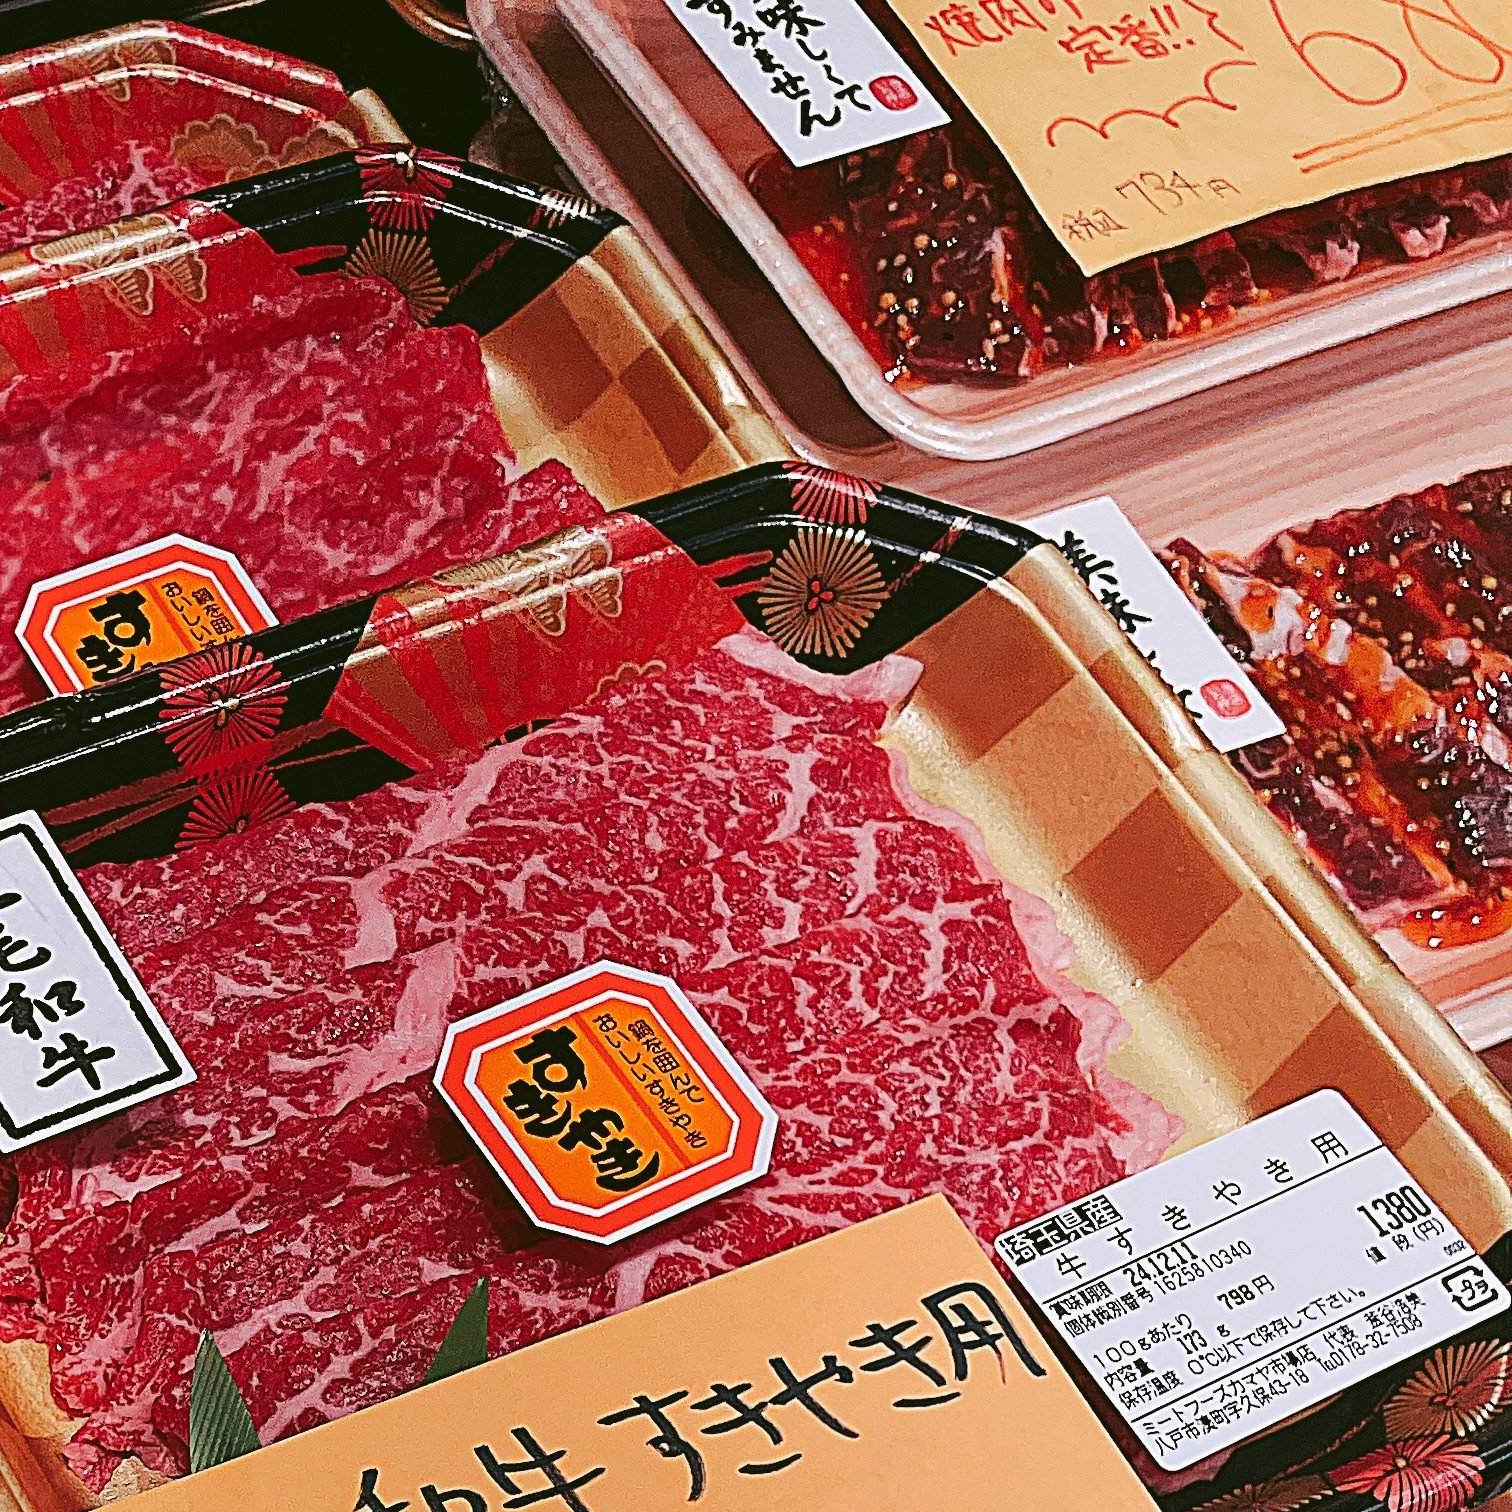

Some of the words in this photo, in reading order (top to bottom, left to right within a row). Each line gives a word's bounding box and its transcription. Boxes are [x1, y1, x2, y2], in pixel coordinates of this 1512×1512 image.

[1269, 0, 1512, 106] 68
[1114, 170, 1242, 216] 734円
[75, 590, 155, 683] すき
[191, 587, 240, 647] 鍋を囲
[592, 1013, 707, 1149] おいしいすきやき
[627, 1019, 705, 1104] 鍋を囲んで
[502, 1025, 661, 1192] すきやき
[999, 1194, 1123, 1266] 埼玉県産
[1056, 1131, 1348, 1279] 牛すきやき用
[1357, 1186, 1431, 1237] 1380
[1123, 1242, 1198, 1287] 24.12.11
[1154, 1241, 1251, 1294] 1625810340
[1143, 1344, 1317, 1435] ミートフーズカマヤ市場店
